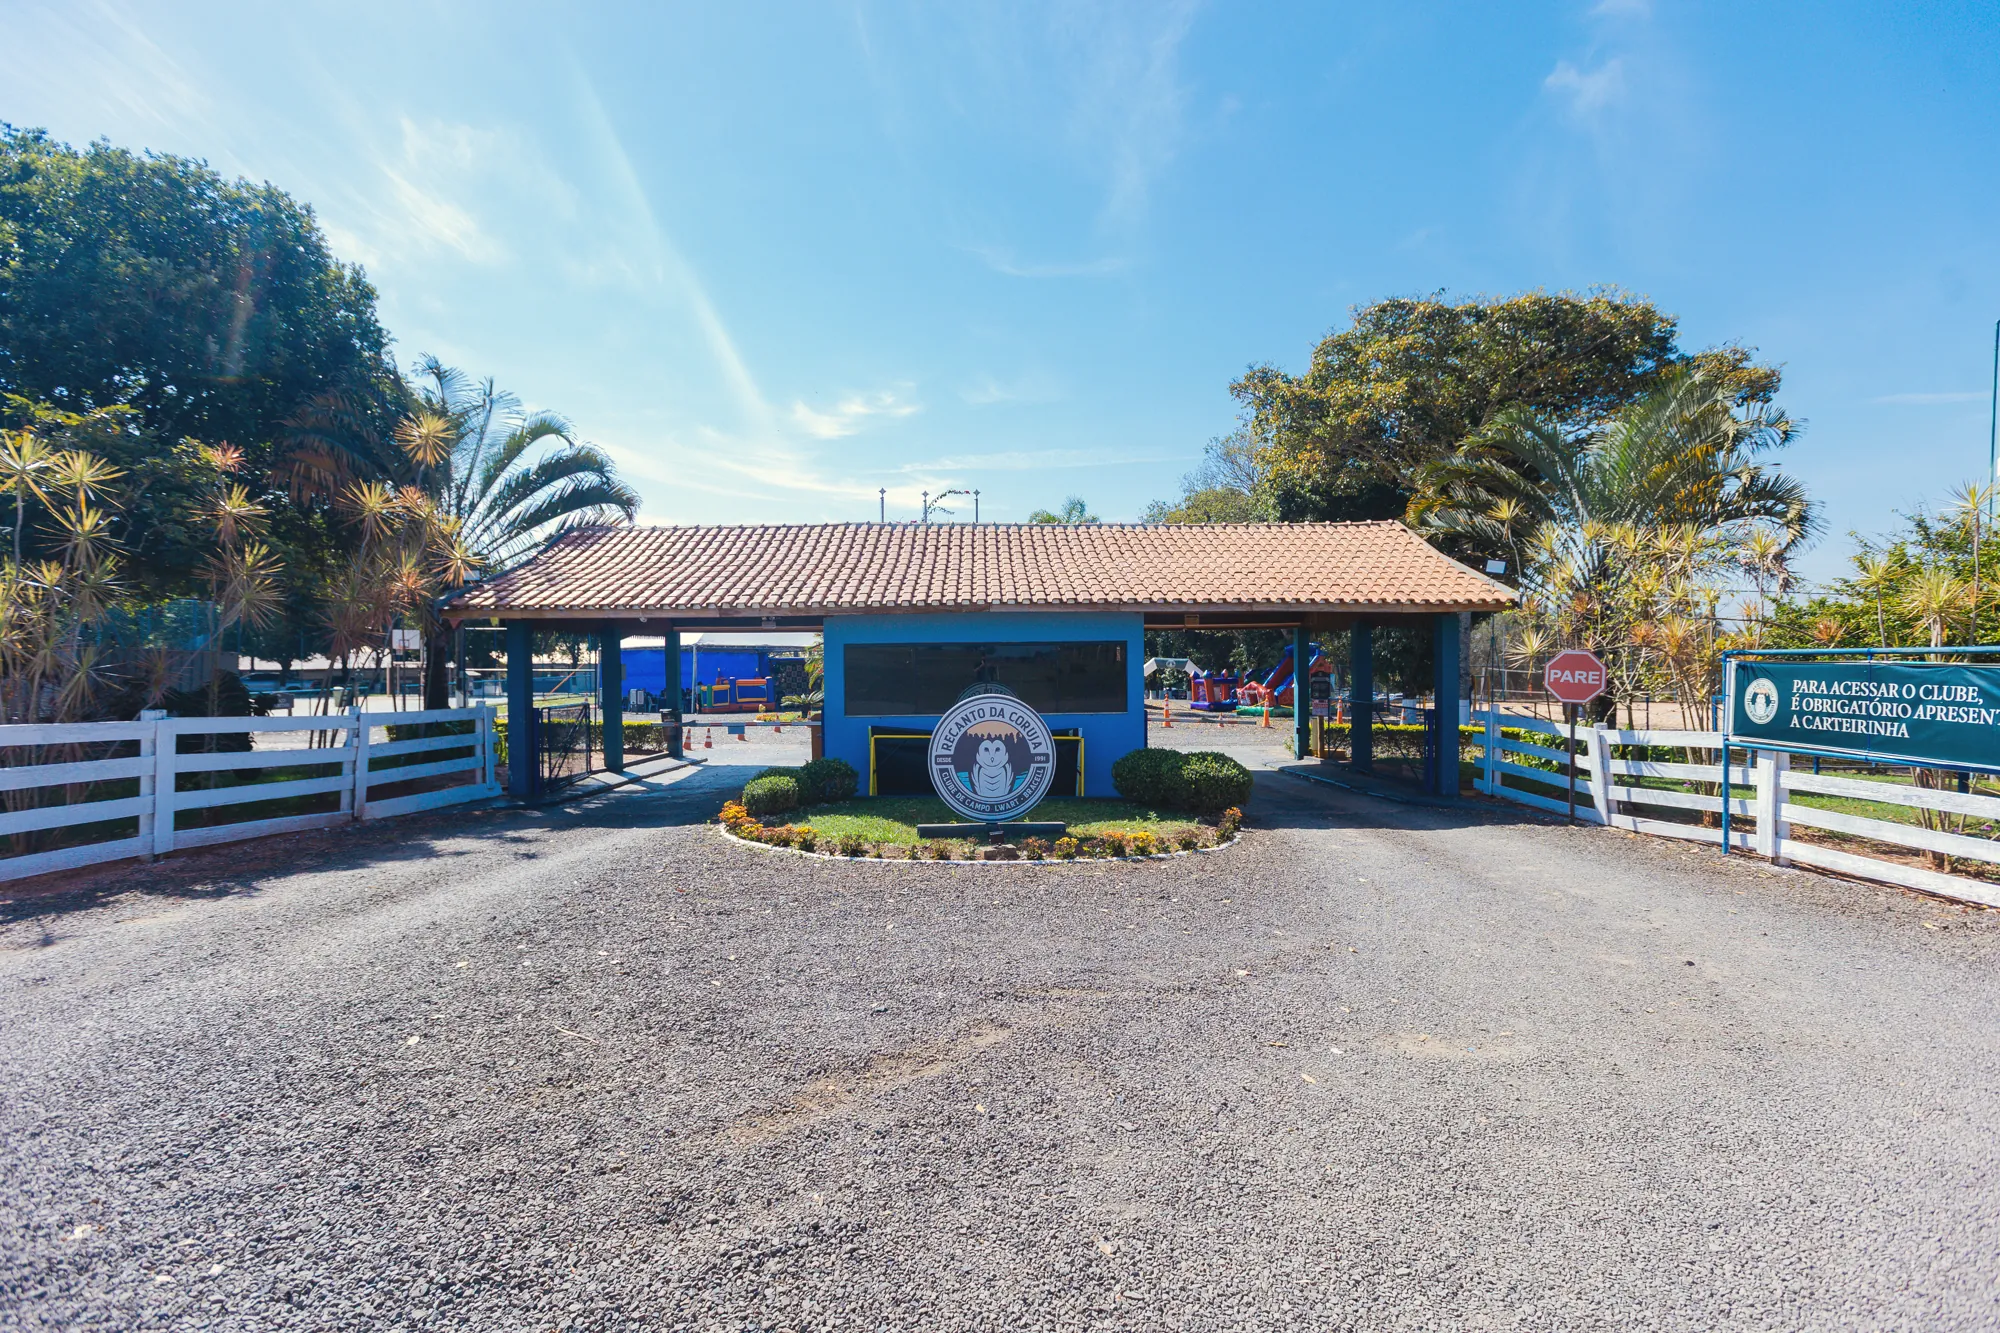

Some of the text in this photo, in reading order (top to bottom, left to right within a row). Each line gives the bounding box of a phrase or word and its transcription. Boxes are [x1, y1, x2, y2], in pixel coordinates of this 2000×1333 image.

[1549, 669, 1601, 685] PARE
[1792, 679, 1984, 705] PARA ACESSAR O CLUBE,
[1790, 693, 1801, 711] É
[1802, 697, 1912, 719] OBRIGATÓRIO
[941, 706, 1043, 752] RECANTO DA CORUJA
[1789, 714, 1911, 738] A CARTEIRINHA
[942, 768, 1044, 812] CLUBE DE CAMPO LWART BRACELL
